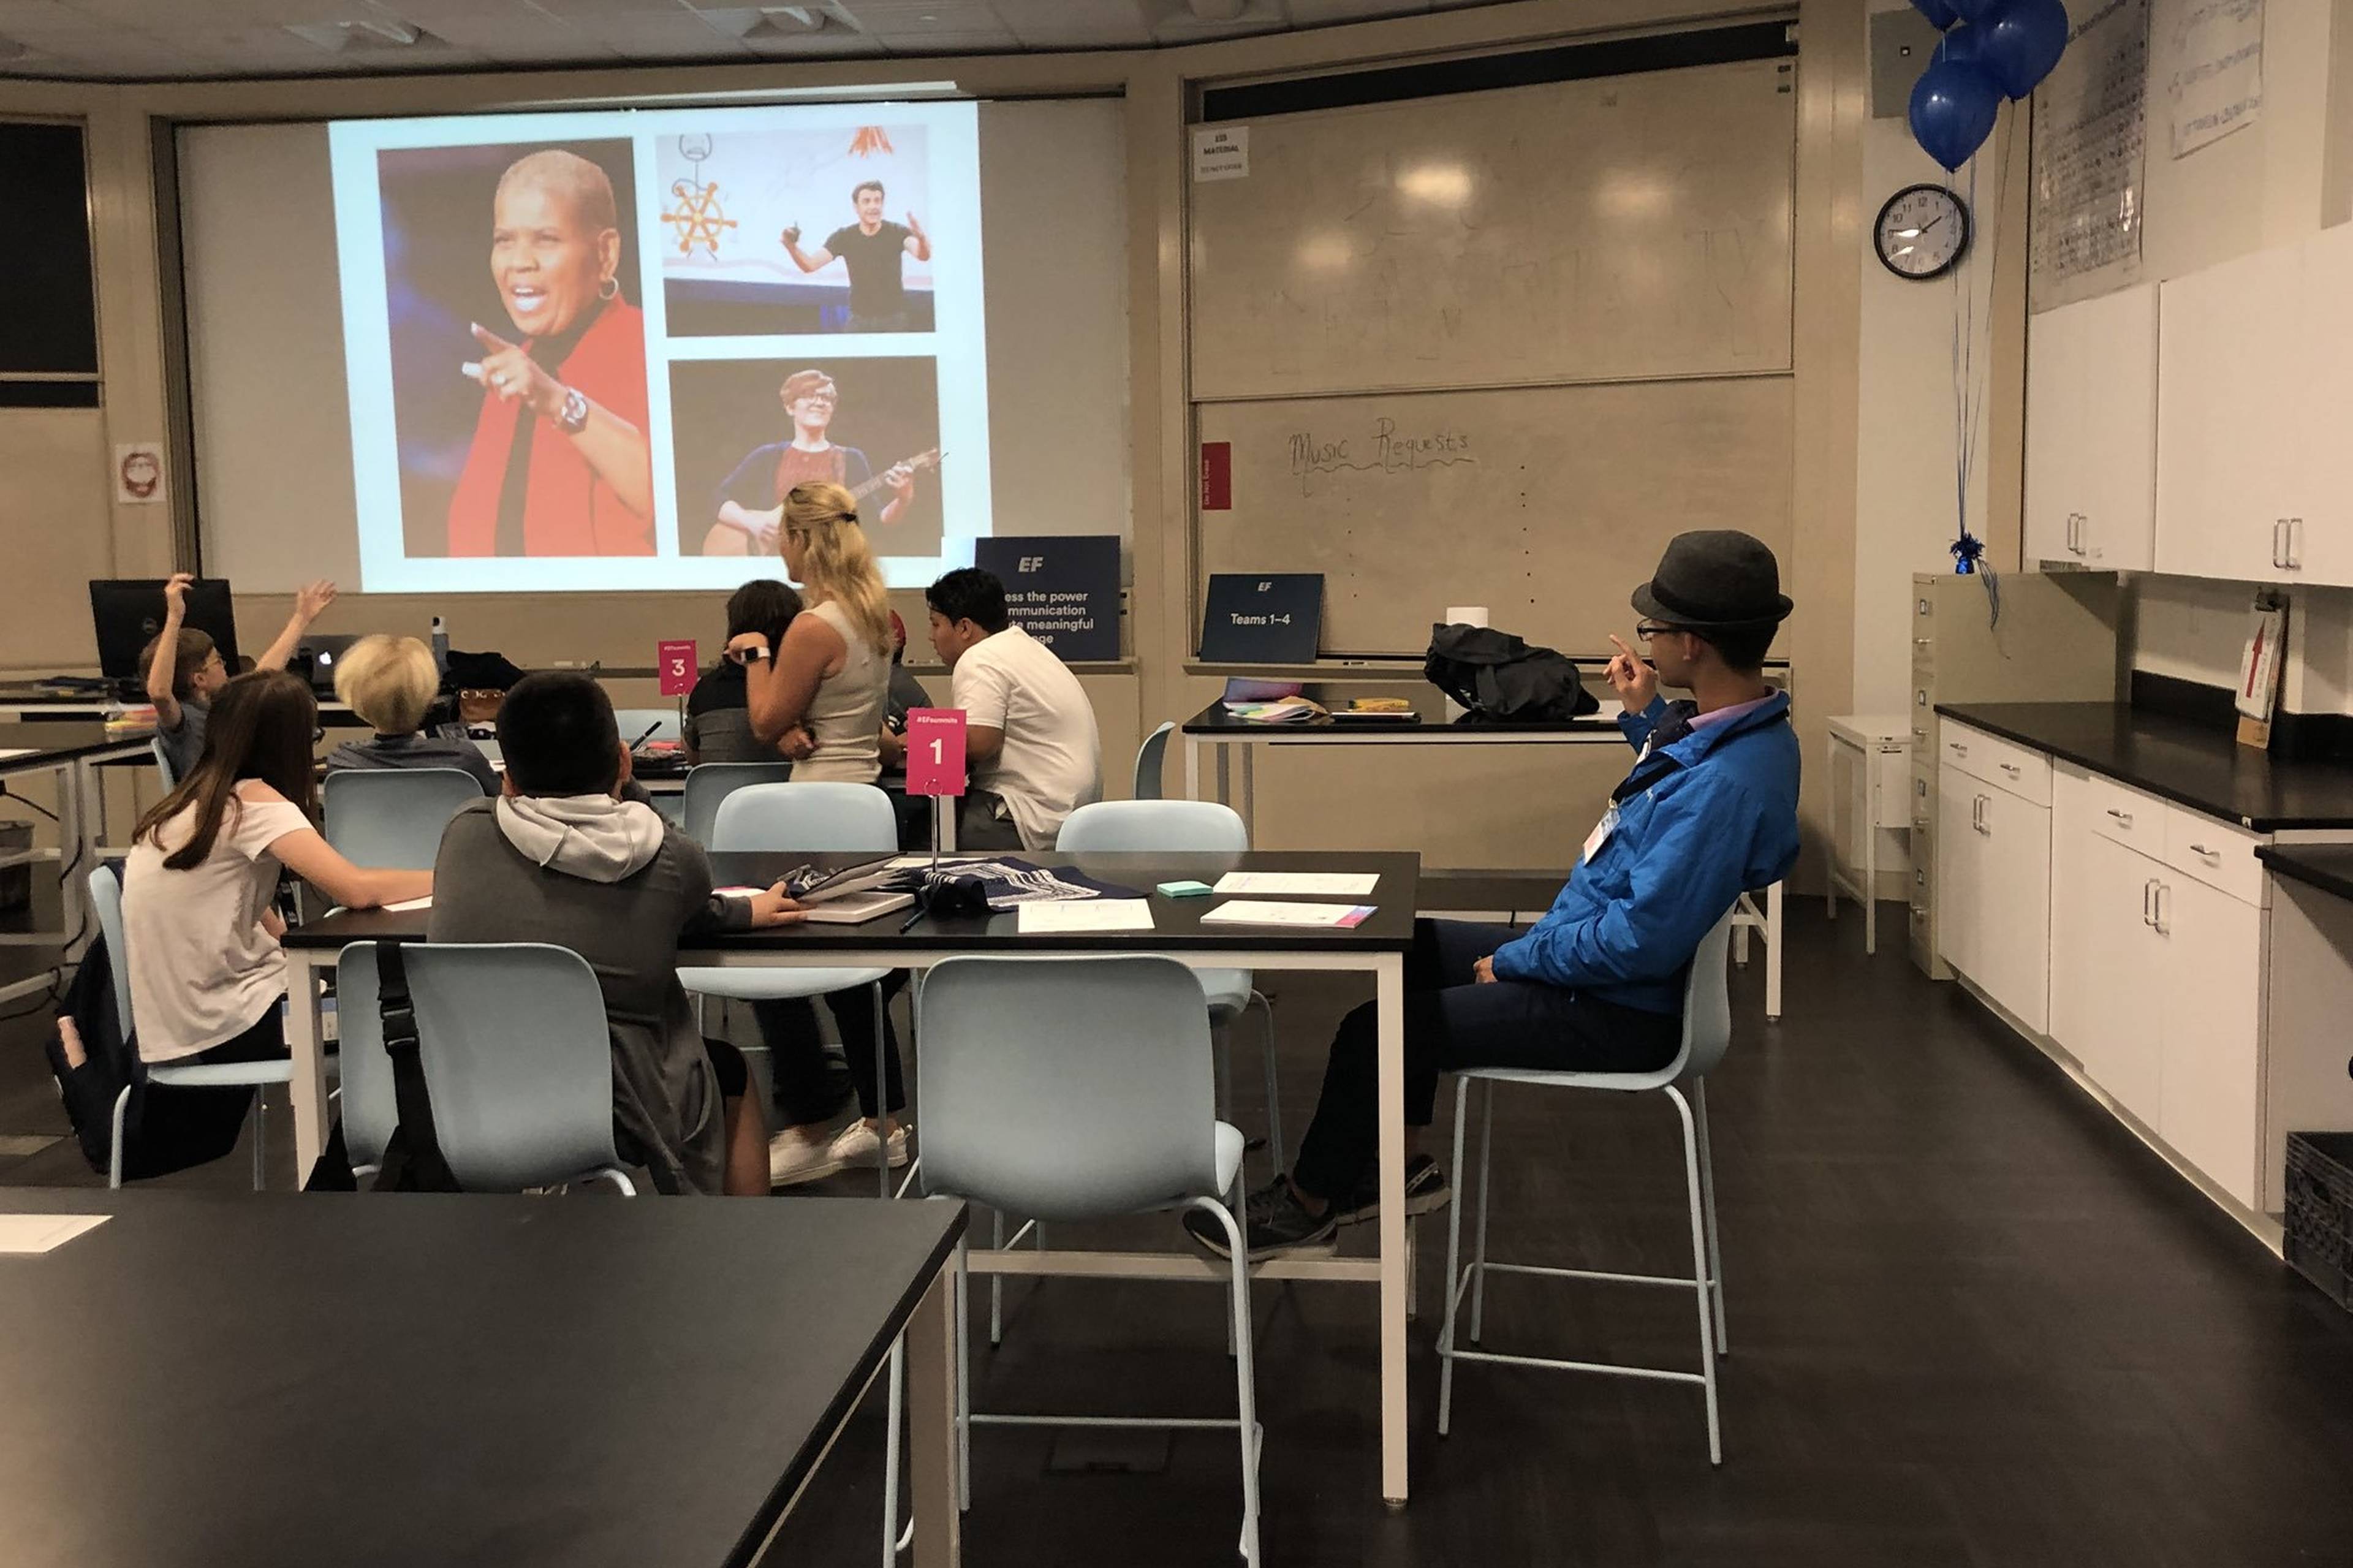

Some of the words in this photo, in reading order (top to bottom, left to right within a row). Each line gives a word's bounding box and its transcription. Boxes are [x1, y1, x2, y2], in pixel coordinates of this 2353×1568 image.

[1918, 197, 1928, 207] 12
[1936, 200, 1939, 210] 1
[1903, 203, 1911, 213] 11
[1893, 213, 1903, 223] 10
[1892, 244, 1898, 254] 8
[1373, 418, 1468, 474] Requests
[1018, 556, 1044, 572] EF
[1258, 581, 1272, 591] EF
[1004, 593, 1024, 602] ess
[1027, 591, 1047, 602] the
[1050, 593, 1088, 604] power
[1007, 604, 1086, 616] mmunication
[1230, 613, 1267, 624] Teams
[1027, 618, 1094, 632] meaningful
[672, 659, 685, 676] 3
[930, 738, 942, 765] 1
